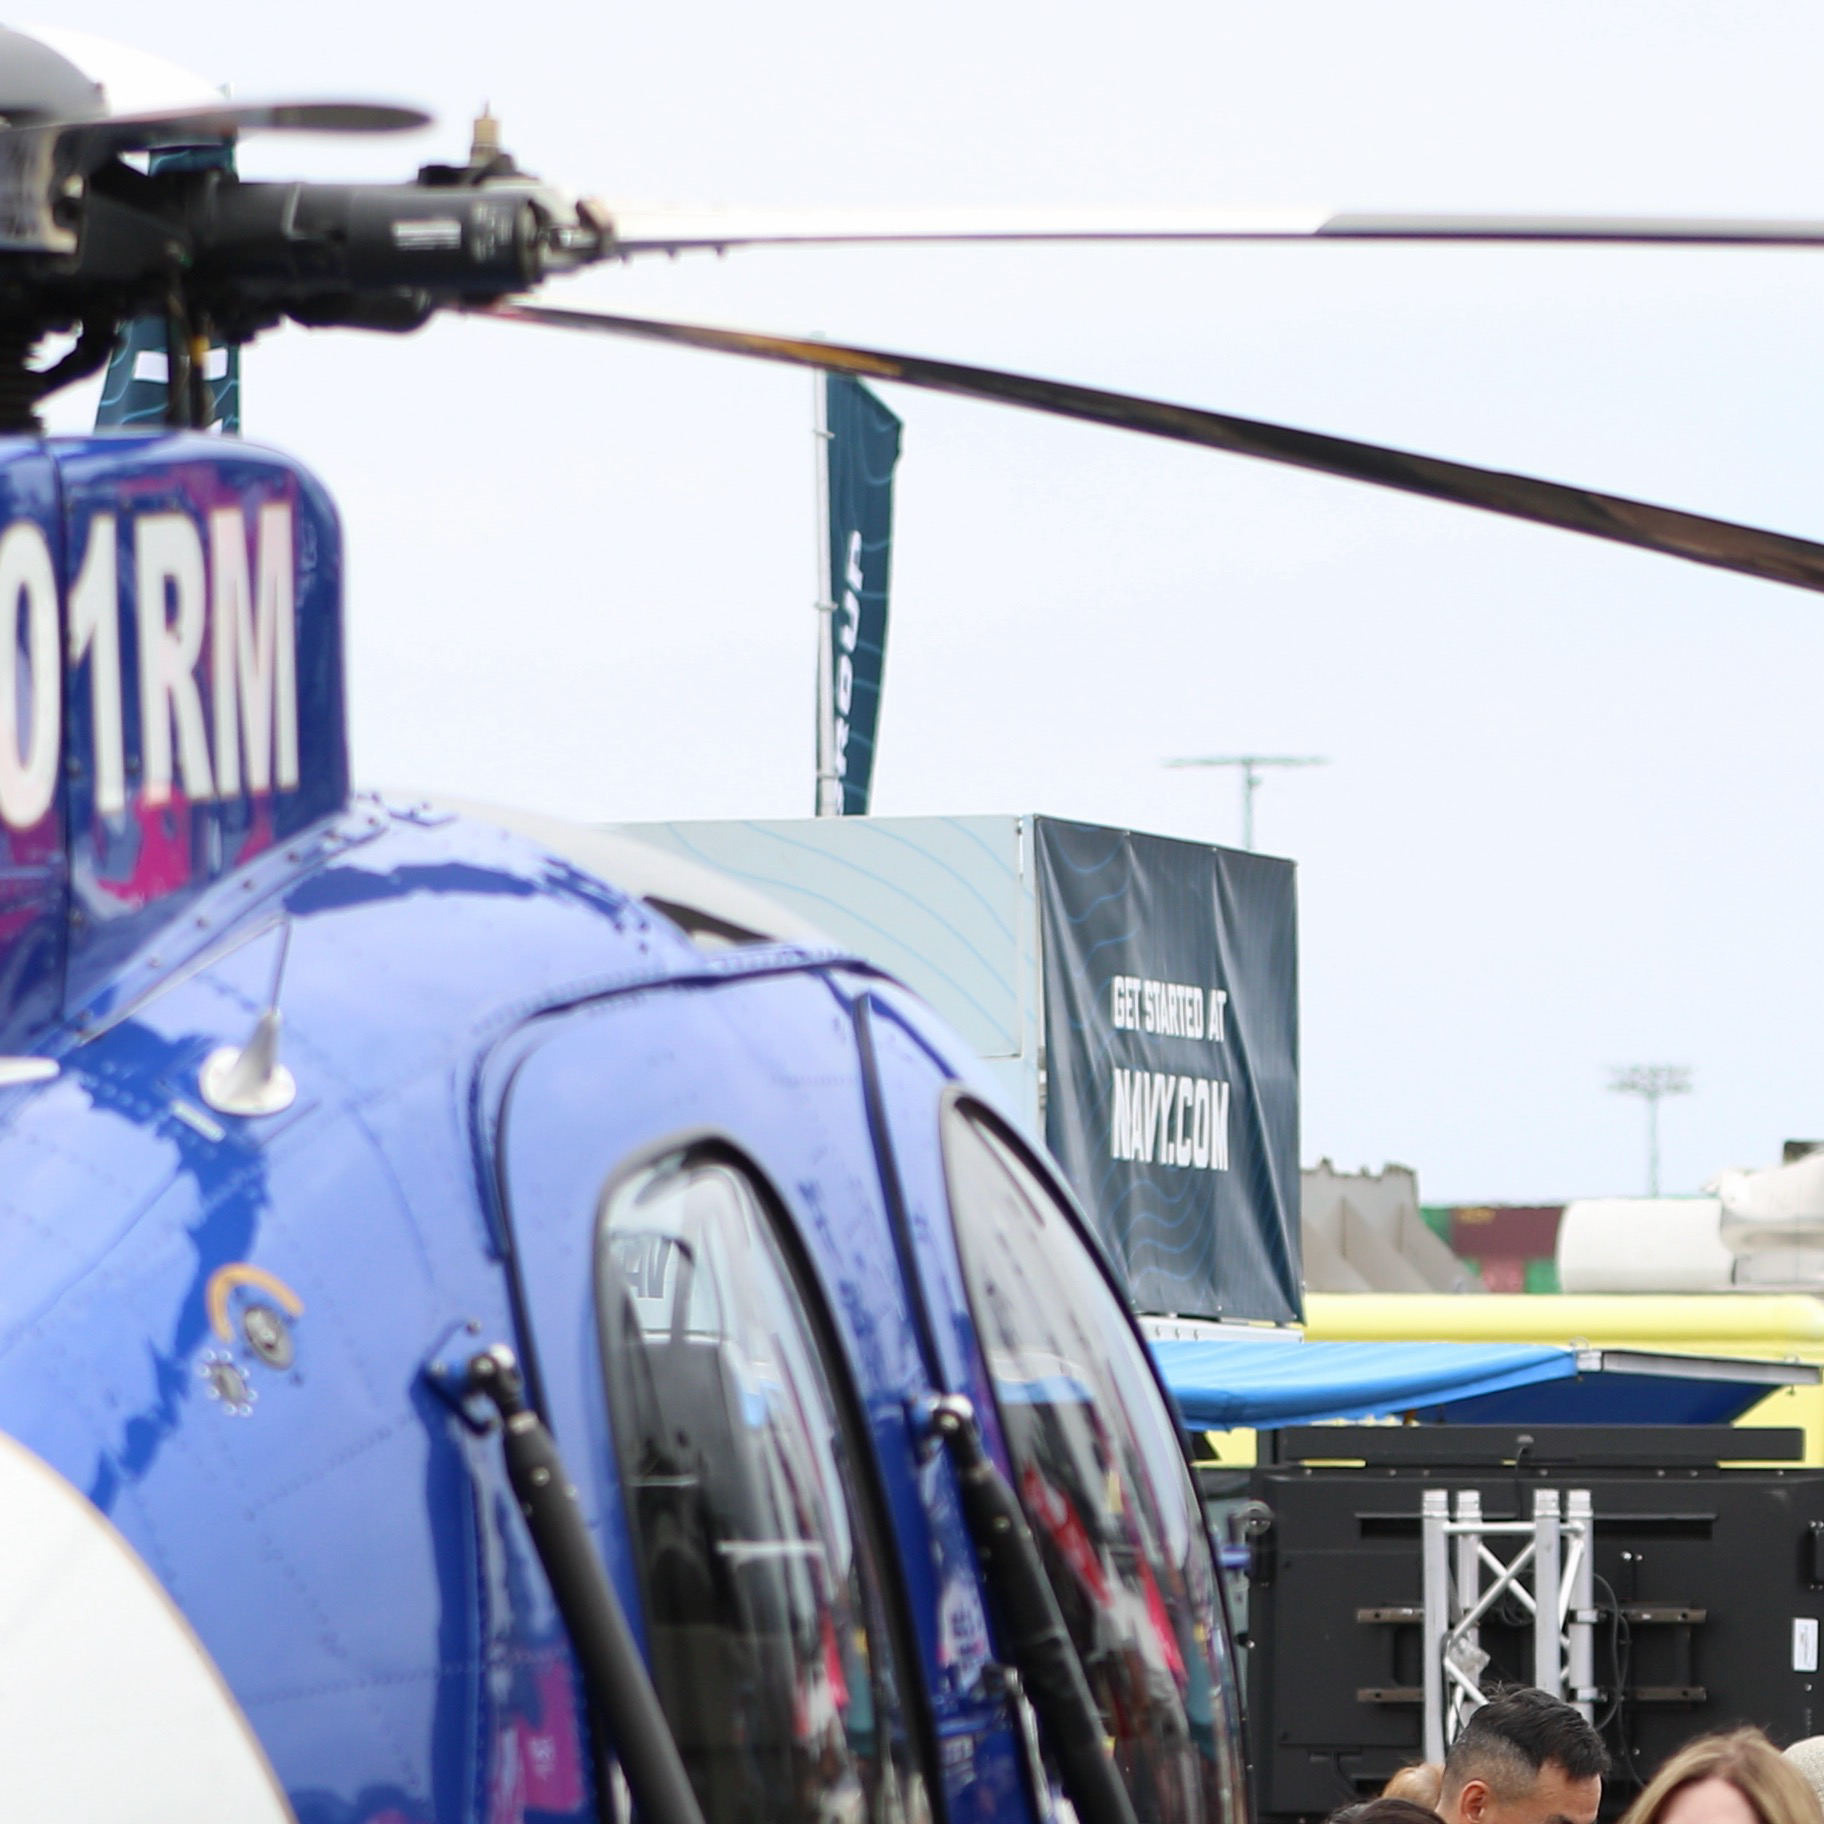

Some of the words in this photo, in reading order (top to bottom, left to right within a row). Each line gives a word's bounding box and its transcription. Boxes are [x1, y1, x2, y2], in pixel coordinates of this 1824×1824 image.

[1113, 975, 1142, 1031] GET
[1142, 980, 1205, 1041] STARTED
[1208, 988, 1228, 1042] AT
[1112, 1067, 1230, 1172] NAVY.COM
